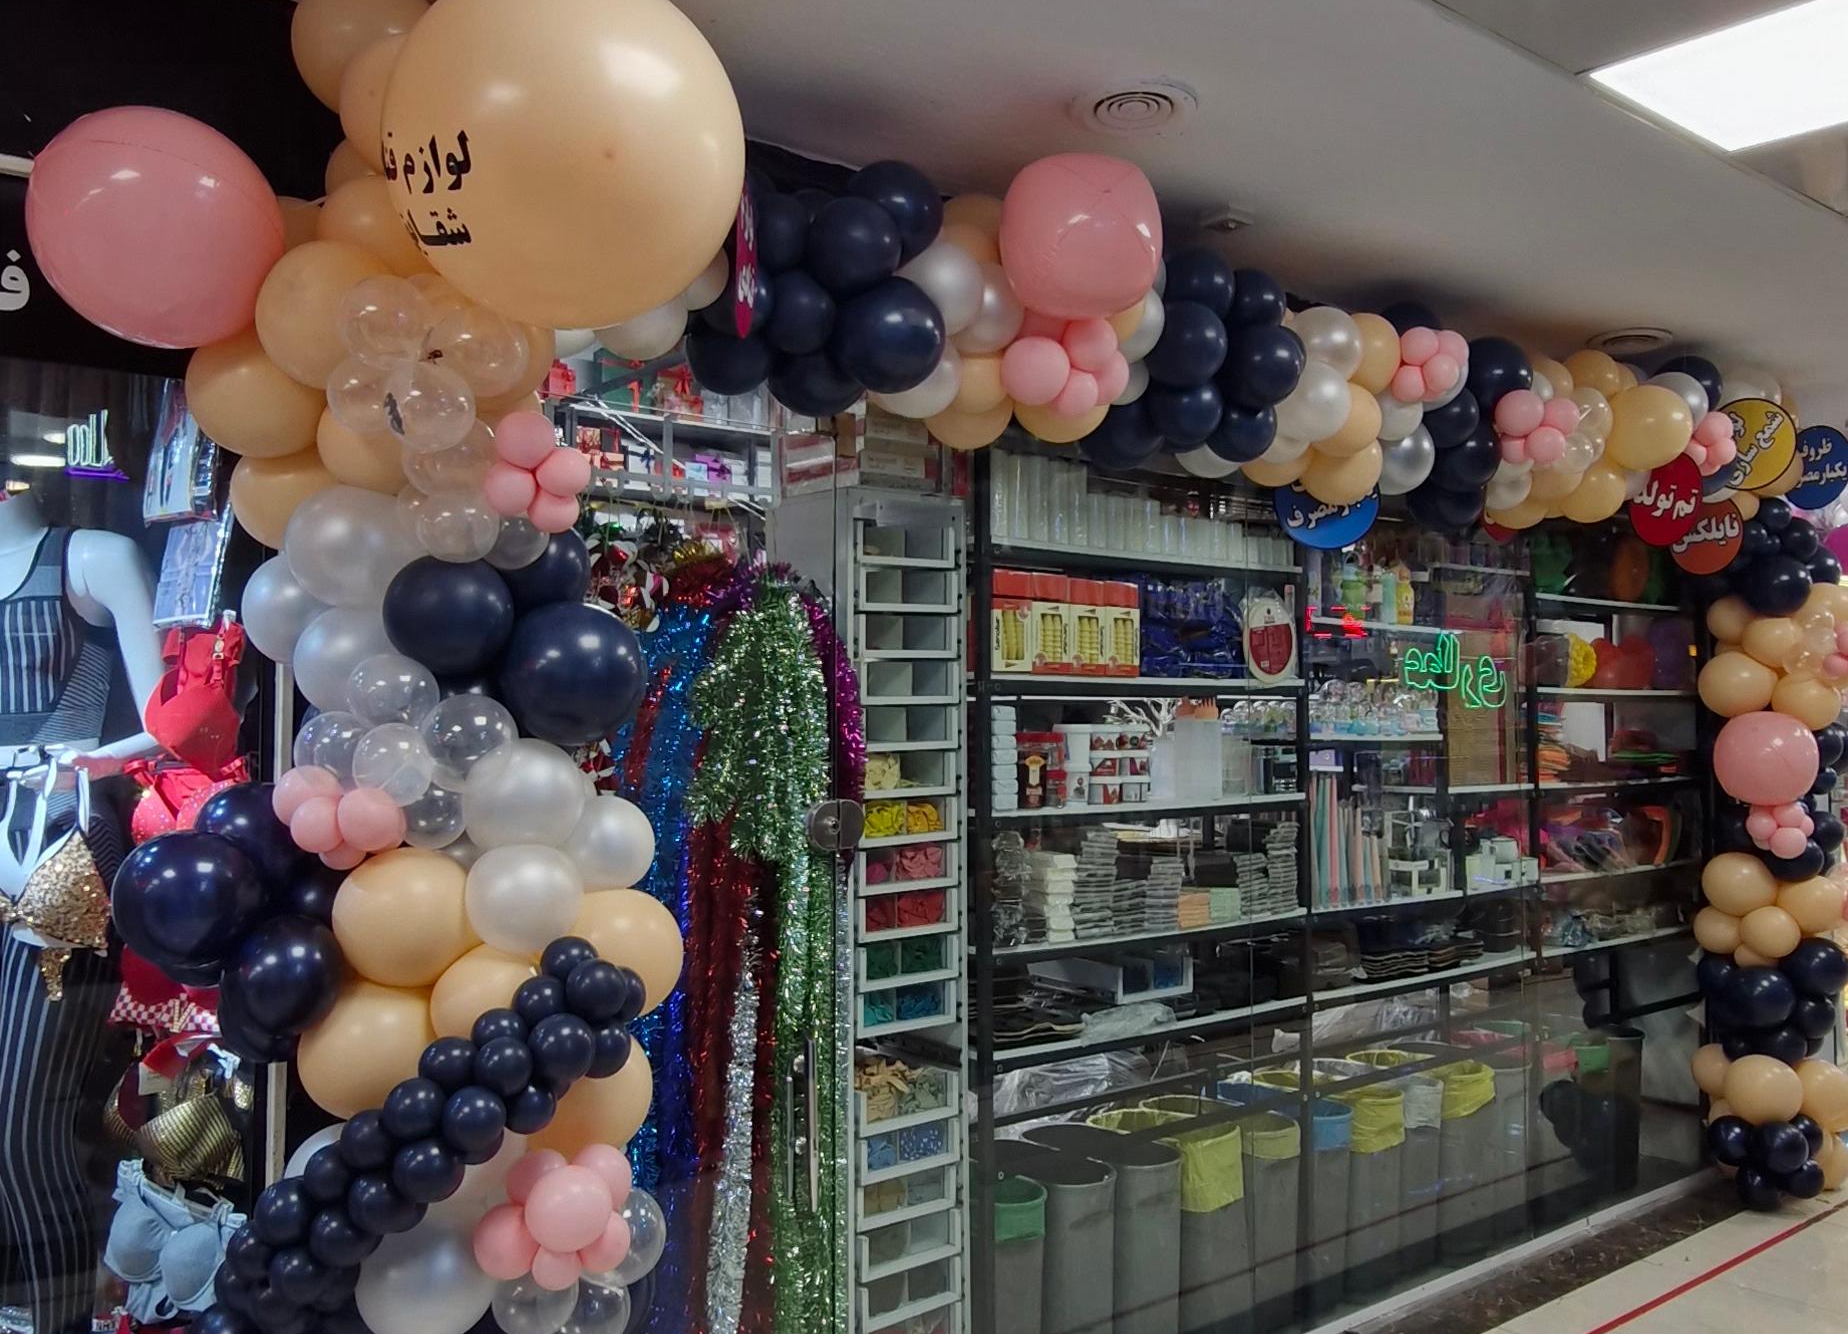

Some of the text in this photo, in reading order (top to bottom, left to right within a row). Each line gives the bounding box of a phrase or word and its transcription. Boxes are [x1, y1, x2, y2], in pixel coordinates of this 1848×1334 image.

[402, 130, 471, 195] لوازم
[1633, 480, 1698, 520] تم تولد
